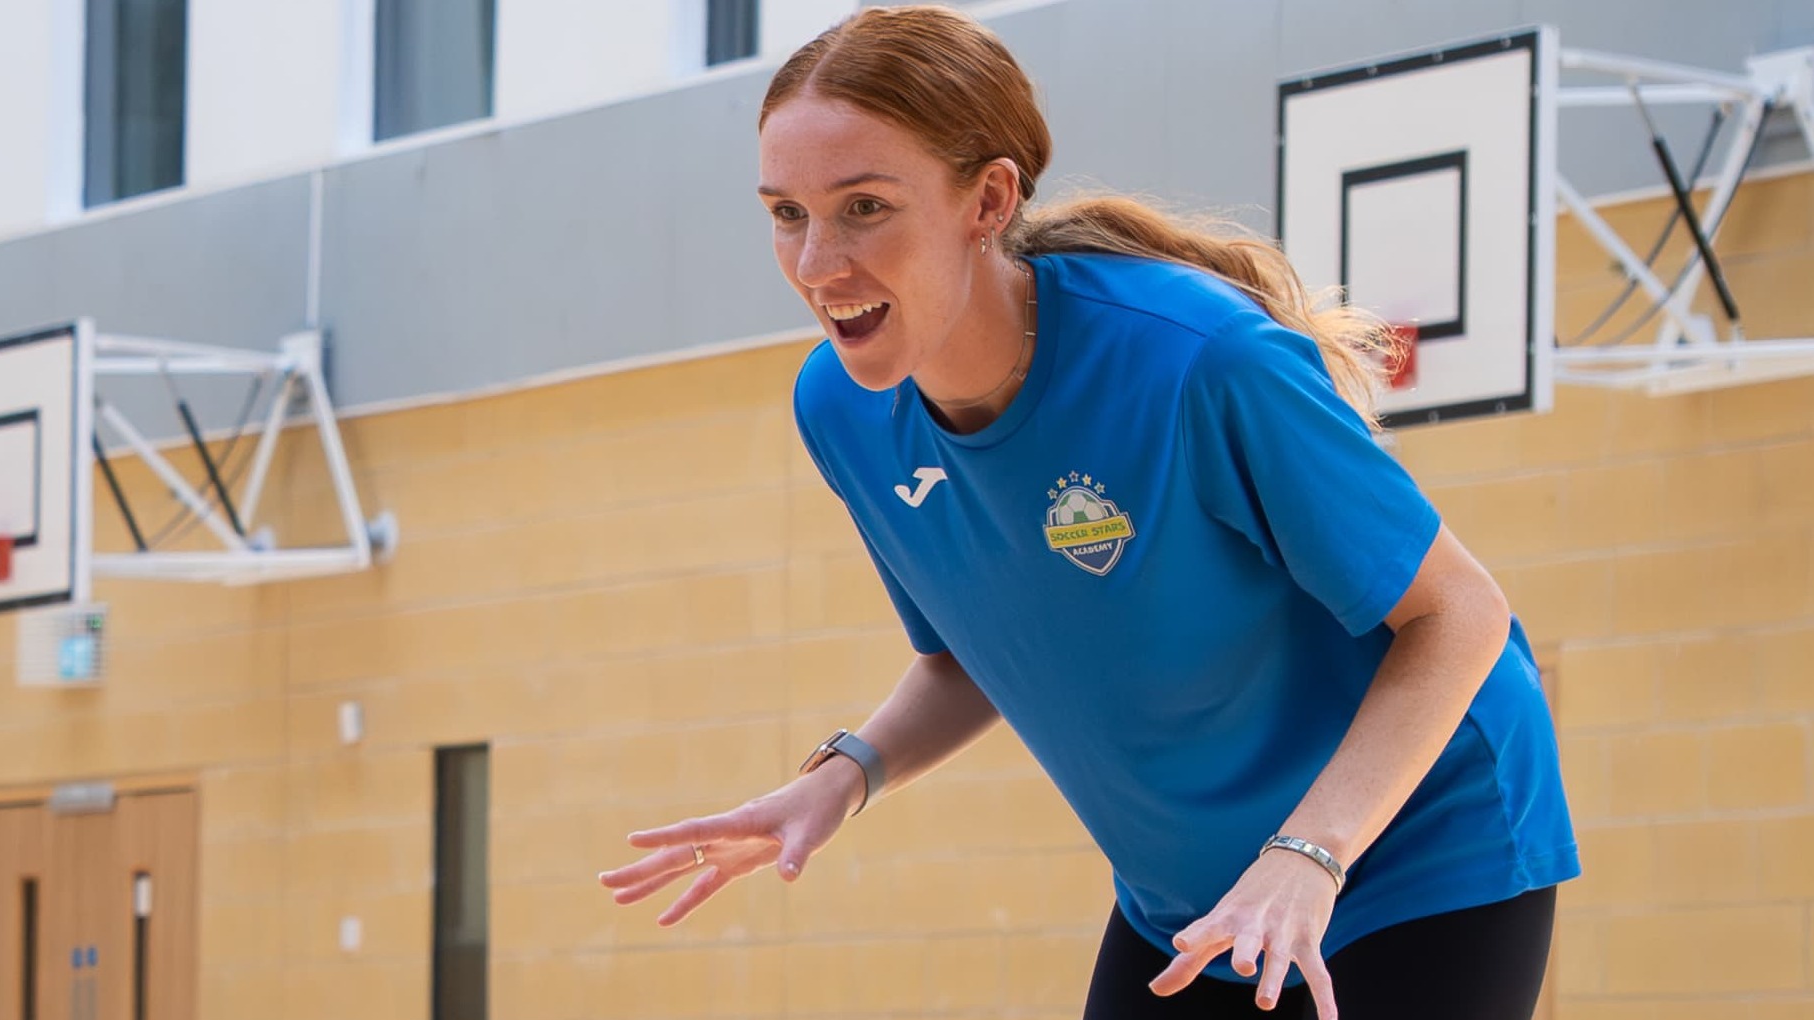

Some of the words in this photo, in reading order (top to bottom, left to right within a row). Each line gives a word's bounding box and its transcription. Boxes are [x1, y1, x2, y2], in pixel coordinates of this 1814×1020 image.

[1050, 529, 1088, 542] SOCCER
[1091, 522, 1126, 536] STARS
[1072, 542, 1113, 556] ACADEMY
